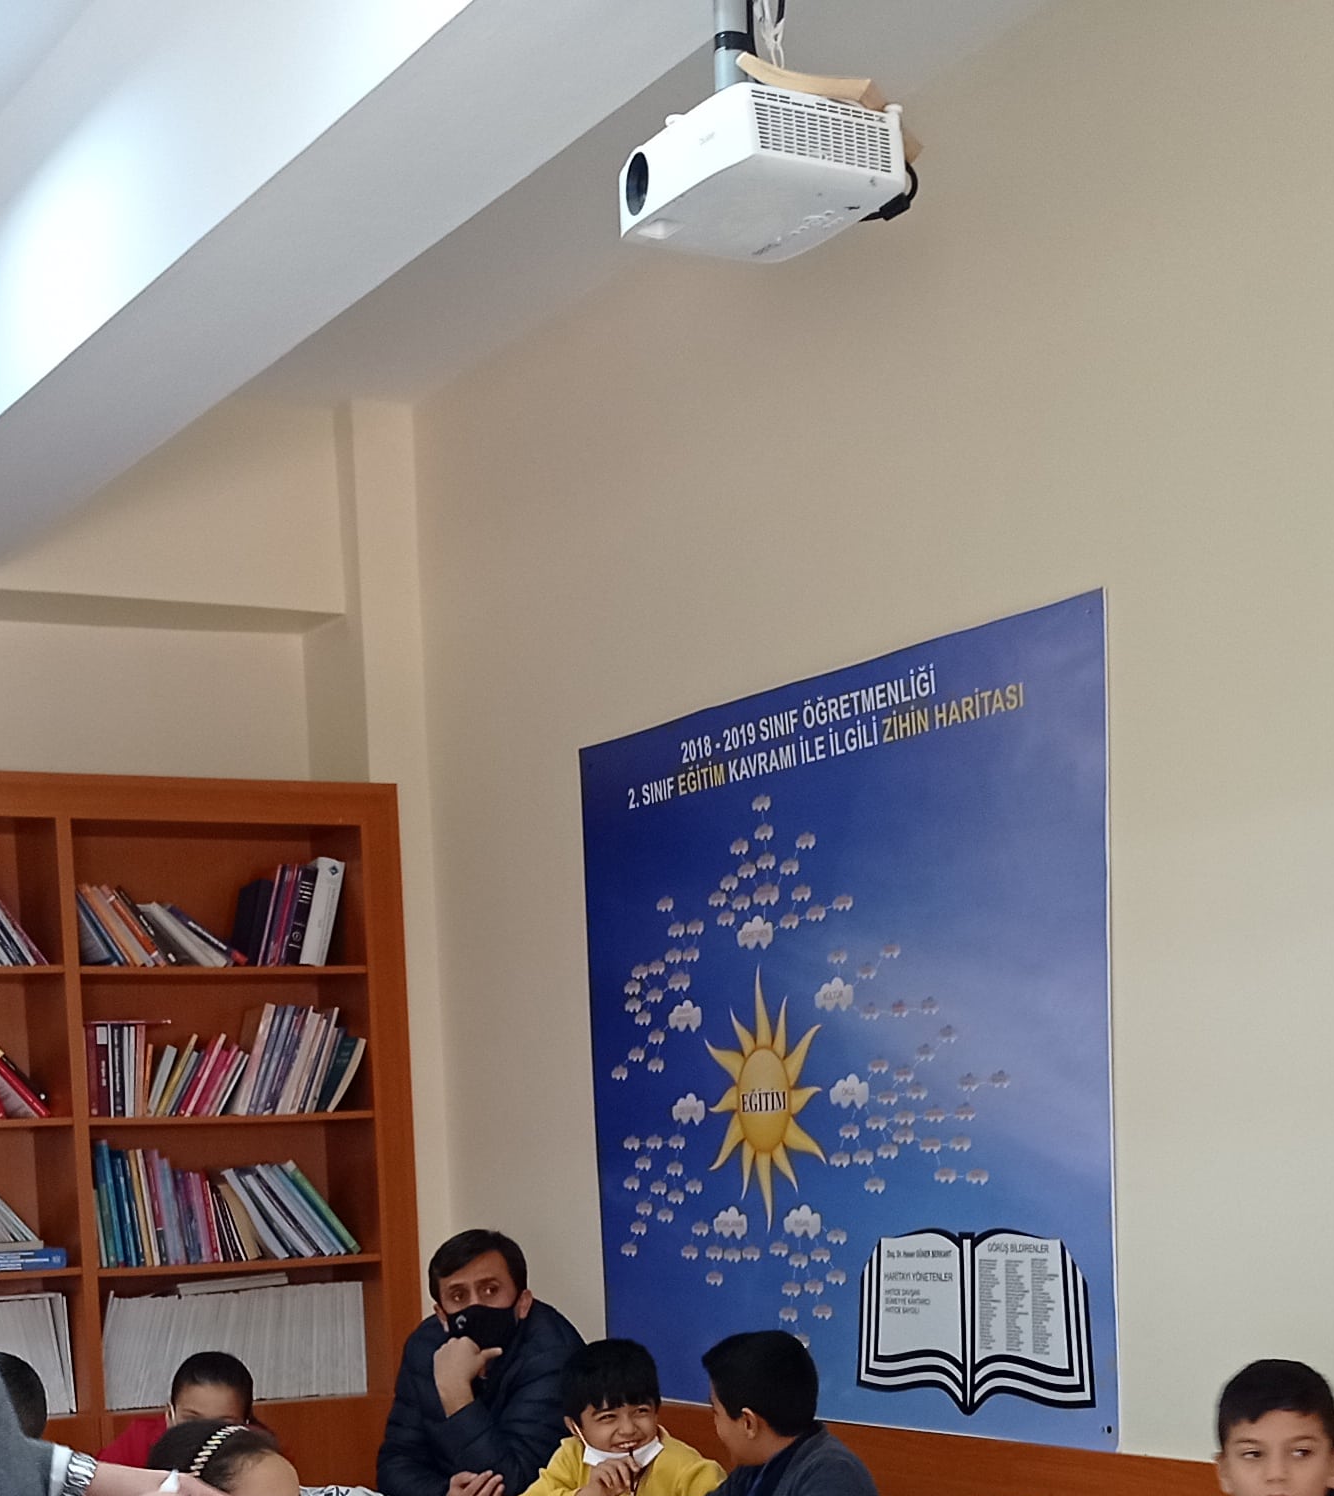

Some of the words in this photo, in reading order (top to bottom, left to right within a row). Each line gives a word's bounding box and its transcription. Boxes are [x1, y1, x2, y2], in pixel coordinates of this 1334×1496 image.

[627, 788, 640, 810] 2.
[642, 776, 675, 806] SINIF
[678, 761, 726, 796] EĞİTİM
[728, 748, 797, 783] KAVRAMI
[799, 736, 827, 765] İLE
[830, 715, 879, 757] İLGİLİ
[882, 703, 930, 743] ZİHİN
[935, 682, 1025, 730] HARİTASI
[681, 737, 714, 764] 2018
[722, 722, 757, 753] 2019
[759, 709, 800, 741] SINIF
[802, 663, 937, 729] ÖĞRETMENLİĞİ
[741, 1087, 787, 1113] EĞİTİM
